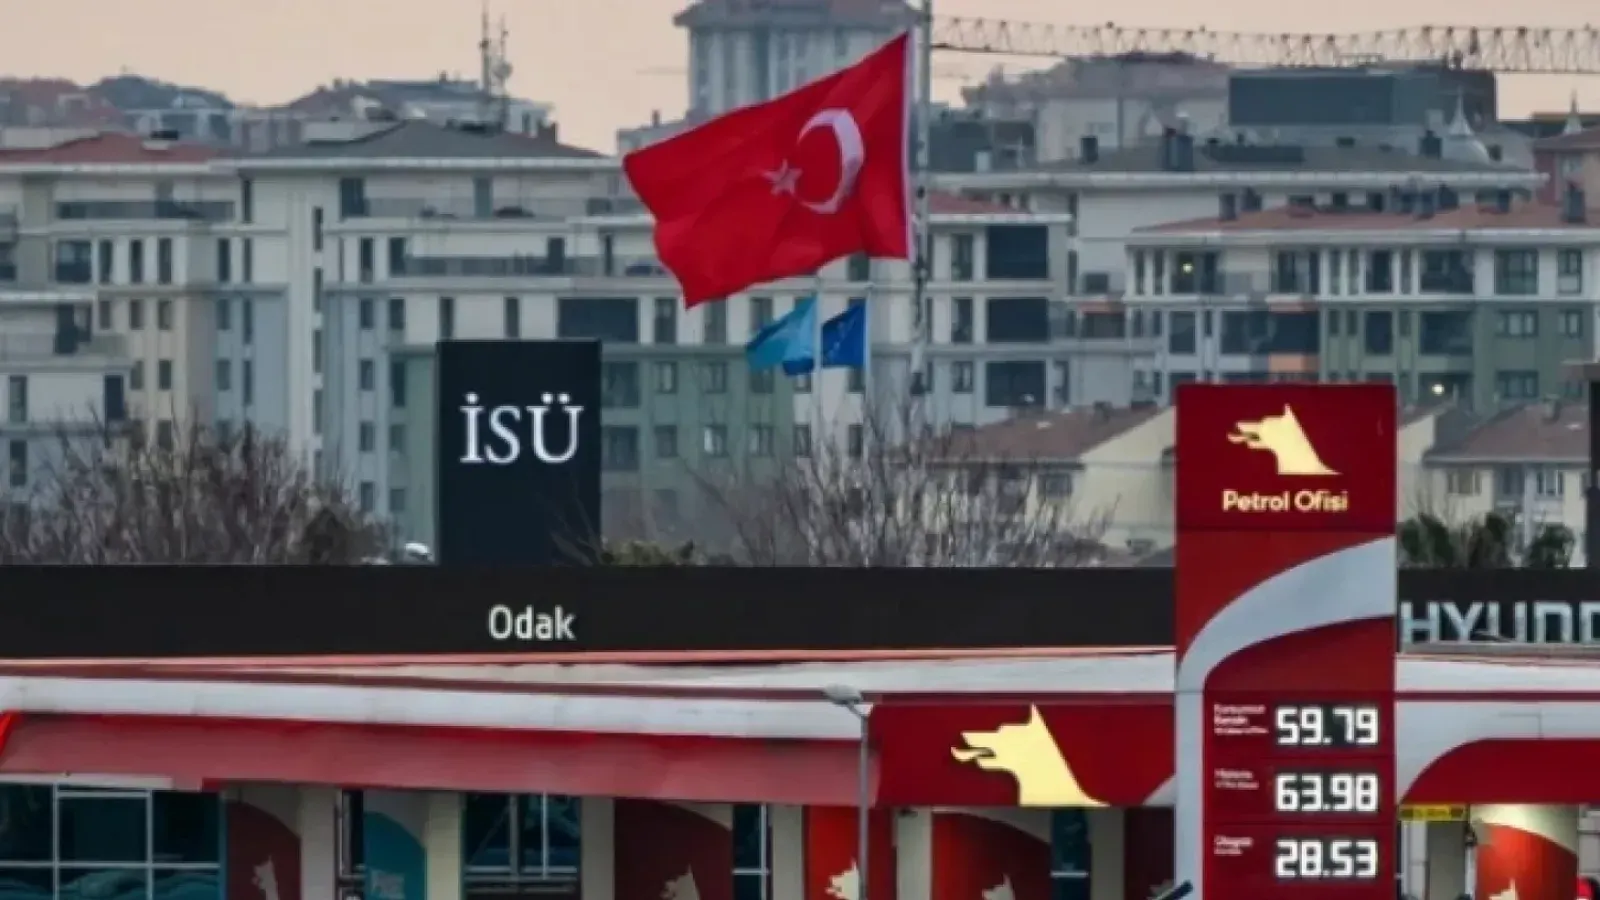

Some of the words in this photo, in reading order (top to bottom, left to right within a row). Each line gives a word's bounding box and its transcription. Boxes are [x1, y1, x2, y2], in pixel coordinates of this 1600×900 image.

[460, 392, 585, 464] İSÜ
[1222, 489, 1290, 512] Petrol
[1294, 489, 1349, 512] Ofisi
[488, 605, 577, 641] Odak
[1275, 706, 1379, 745] 59.79
[1275, 774, 1379, 812] 63.98
[1275, 839, 1379, 878] 28.53
